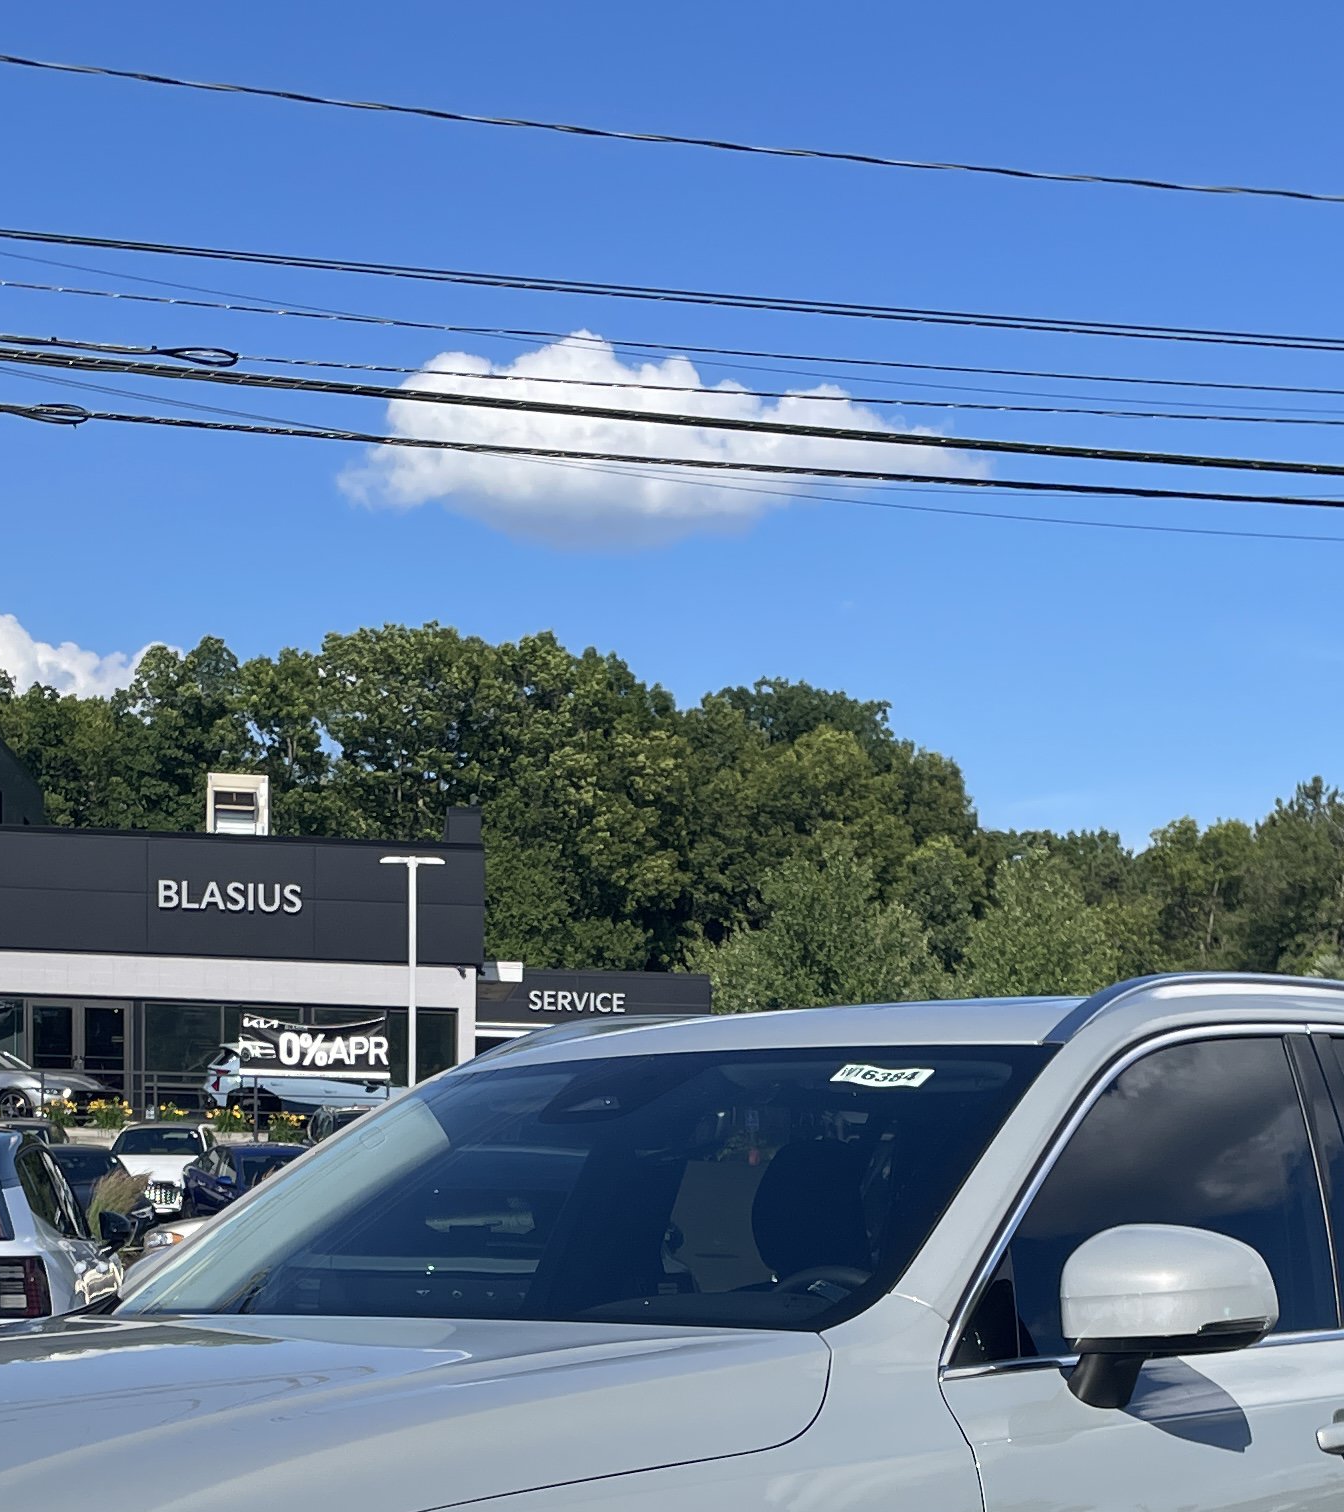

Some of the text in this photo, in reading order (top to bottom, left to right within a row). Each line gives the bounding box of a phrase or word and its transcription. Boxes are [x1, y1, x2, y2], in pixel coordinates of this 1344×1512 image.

[158, 879, 303, 913] BLASIUS
[529, 990, 626, 1013] SERVICE
[243, 1017, 278, 1028] KIA
